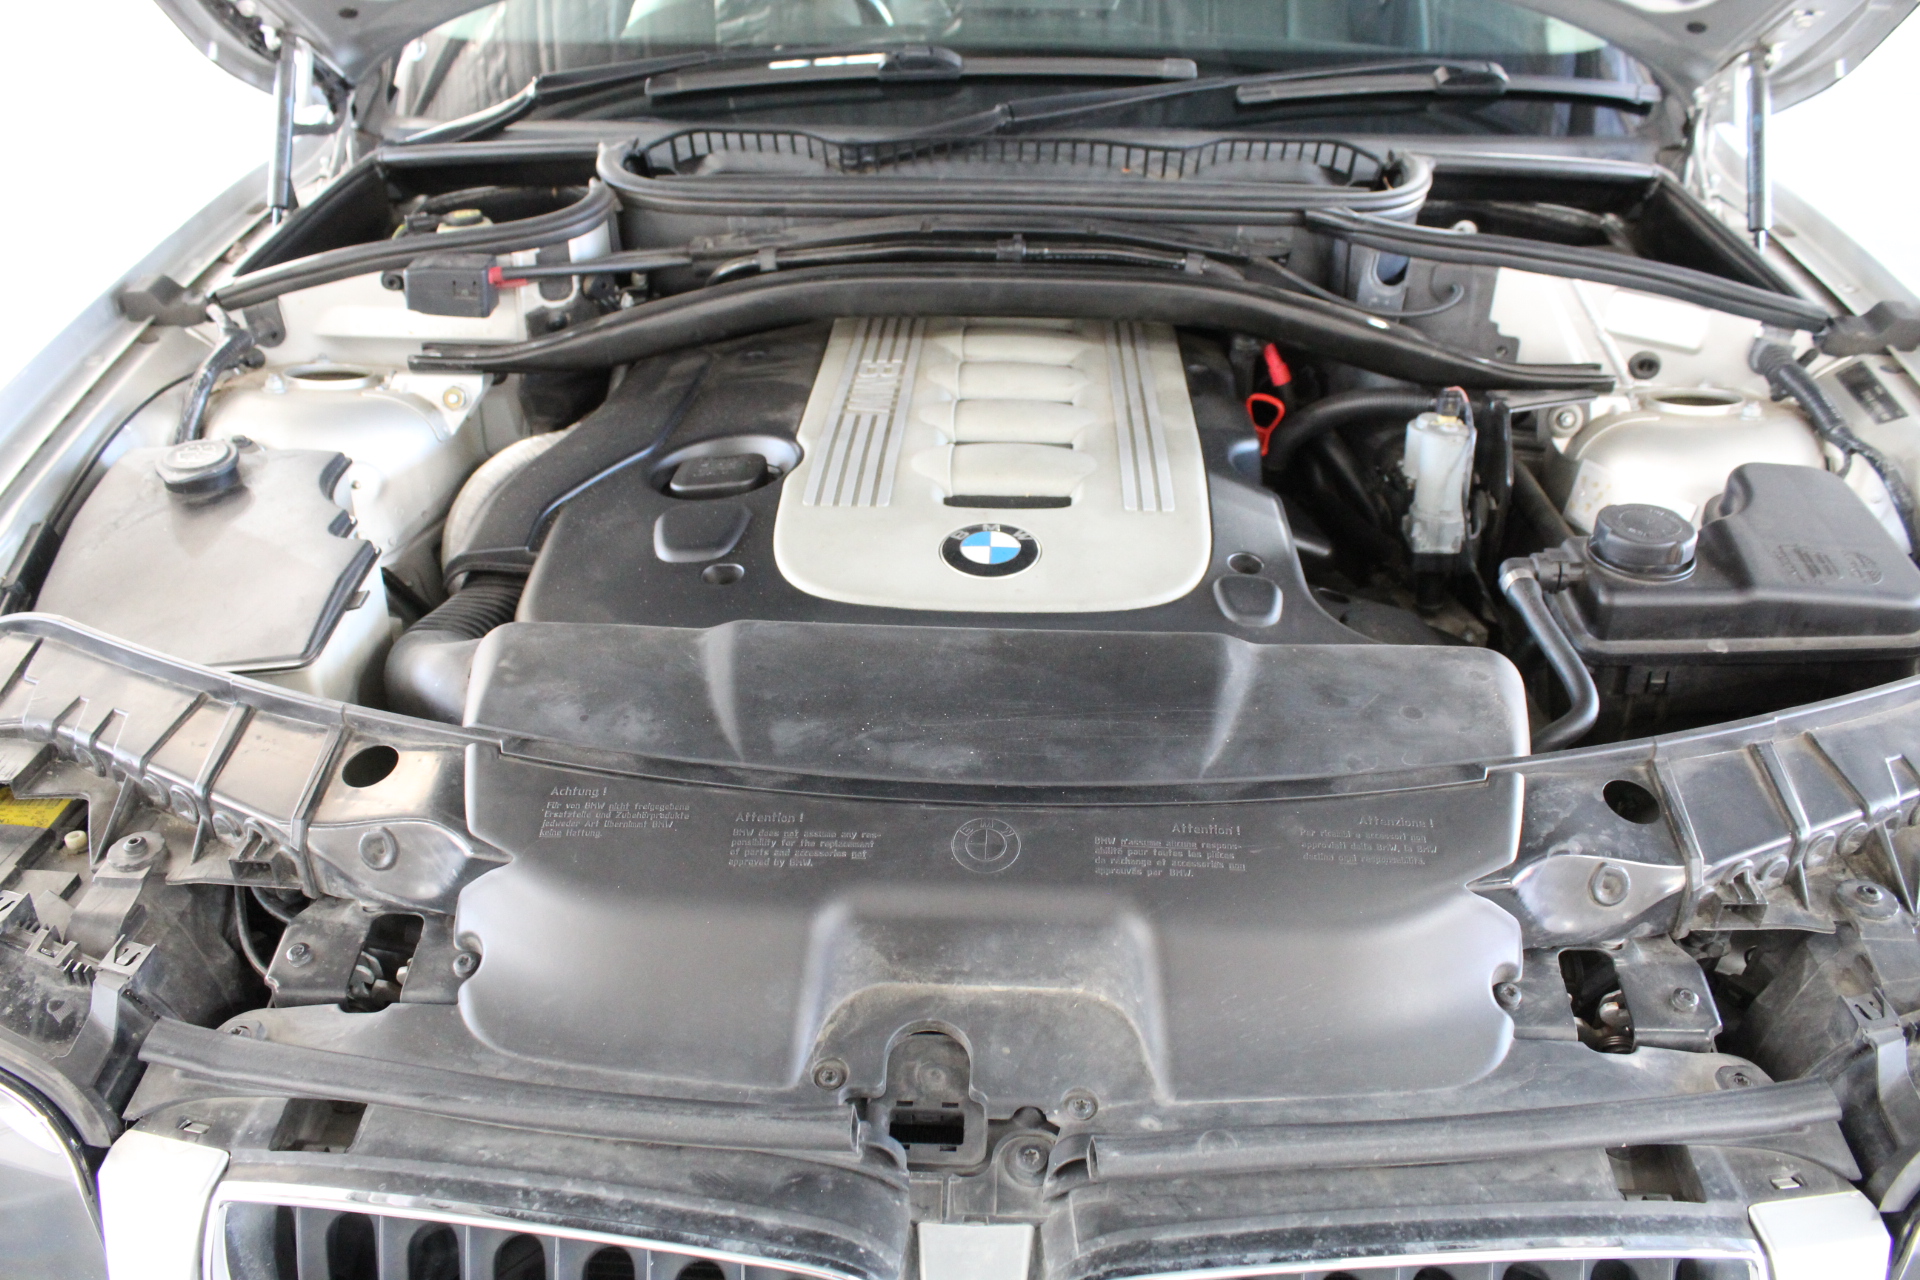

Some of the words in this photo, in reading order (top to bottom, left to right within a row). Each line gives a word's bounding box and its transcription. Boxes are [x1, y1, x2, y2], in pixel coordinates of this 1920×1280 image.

[846, 359, 902, 413] BMW
[950, 524, 1033, 541] BMW
[551, 786, 599, 798] Achtung
[609, 803, 630, 812] nicht
[635, 803, 690, 812] freigegebene
[544, 810, 591, 818] Ersatzteile
[615, 811, 690, 821] Zubehörprodukte
[735, 812, 796, 823] Attention
[541, 820, 581, 828] jedweder
[584, 820, 599, 828] Art
[1359, 816, 1426, 828] Attenzione
[539, 828, 562, 838] keine
[566, 828, 603, 839] Haftung.
[959, 819, 1015, 838] BMW
[1172, 823, 1233, 836] Attention
[733, 829, 755, 837] BMW
[758, 829, 780, 837] does
[783, 829, 799, 839] not
[841, 832, 858, 840] any
[1300, 829, 1316, 837] Per
[1320, 830, 1351, 838] ricambi
[1366, 832, 1407, 841] accessori
[1411, 835, 1427, 843] non
[731, 838, 777, 848] ponsibility
[781, 839, 796, 847] for
[801, 839, 816, 847] the
[820, 840, 875, 849] replacement
[1095, 836, 1116, 845] BMW
[1166, 841, 1198, 850] aucune
[730, 848, 741, 856] of
[744, 848, 770, 858] parts
[794, 849, 847, 857] accessories
[851, 850, 868, 860] not
[1127, 849, 1148, 857] pour
[1153, 849, 1184, 857] toutes
[1188, 850, 1202, 858] les
[1404, 845, 1413, 853] la
[1417, 845, 1437, 853] BMW
[728, 858, 770, 867] approved
[774, 858, 785, 868] by
[789, 858, 813, 867] BMW.
[1095, 856, 1106, 864] de
[1156, 858, 1166, 866] et
[1229, 863, 1246, 871] non
[1338, 854, 1358, 865] ogni
[1147, 869, 1163, 877] par
[1170, 868, 1194, 877] BMW.
